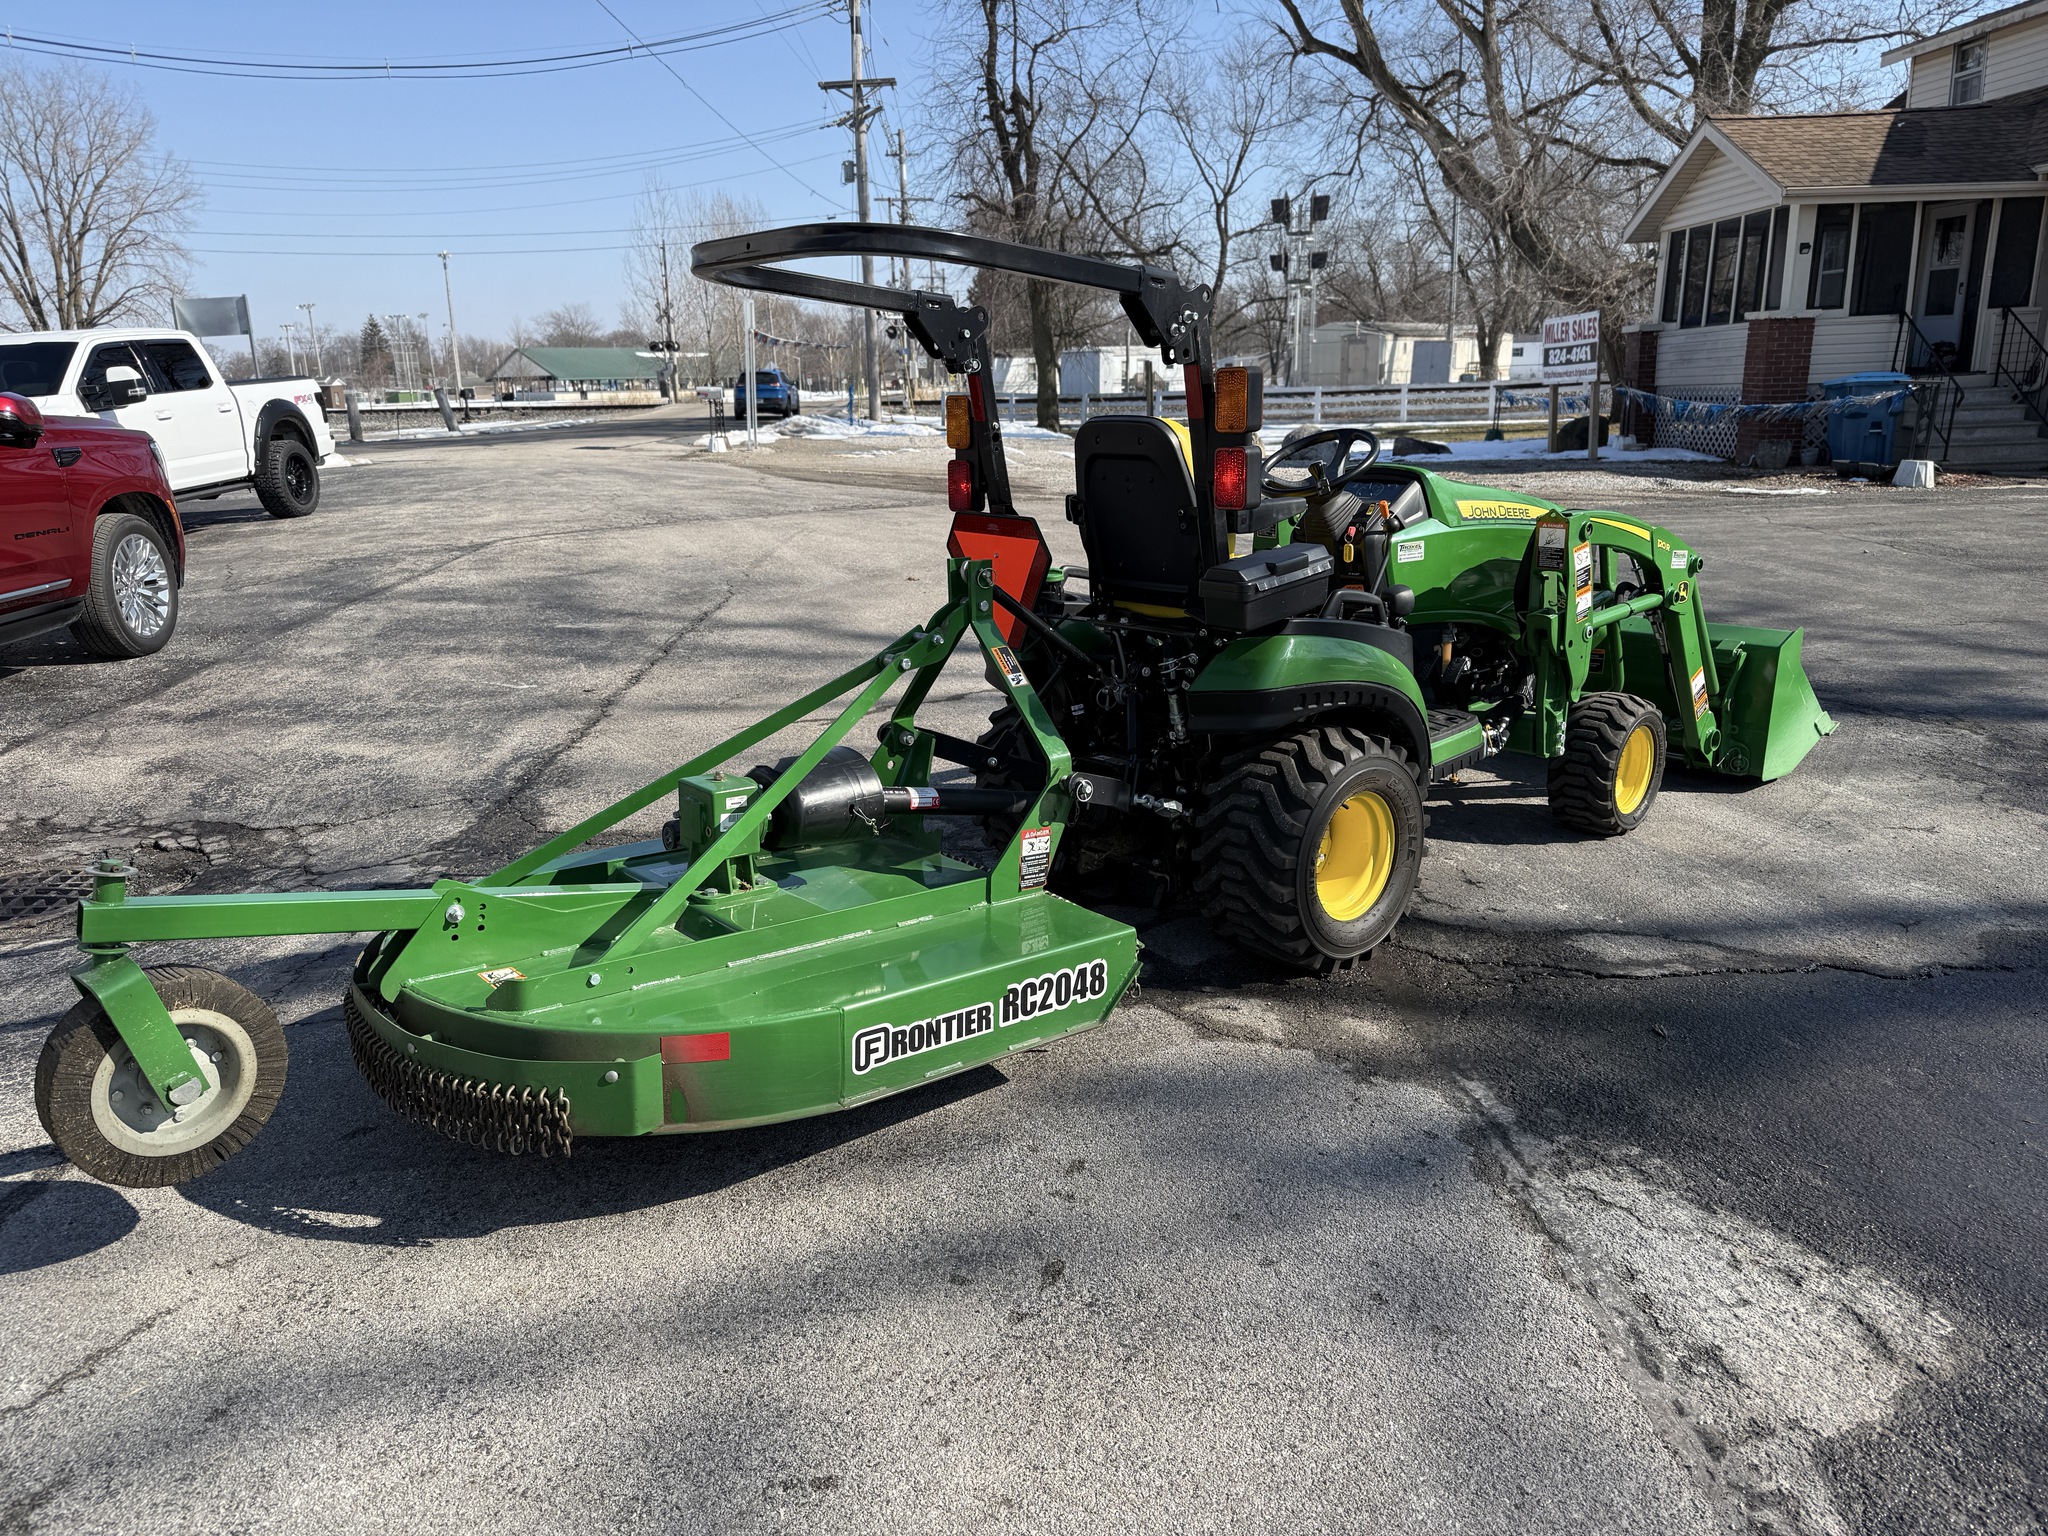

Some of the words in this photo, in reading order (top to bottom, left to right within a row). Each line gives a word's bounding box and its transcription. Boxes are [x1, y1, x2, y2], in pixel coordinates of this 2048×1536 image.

[1545, 322, 1570, 344] MILLER
[1572, 317, 1597, 341] SALES
[1549, 345, 1591, 364] 824-4141
[294, 394, 313, 404] FX4
[1468, 505, 1497, 517] JOHN
[1498, 505, 1531, 517] DEERE
[14, 527, 70, 540] DENALI
[1386, 777, 1417, 861] CARLISLE
[1030, 829, 1050, 838] DANGER
[855, 1004, 992, 1072] FRONTIER
[1003, 962, 1106, 1023] RC2048
